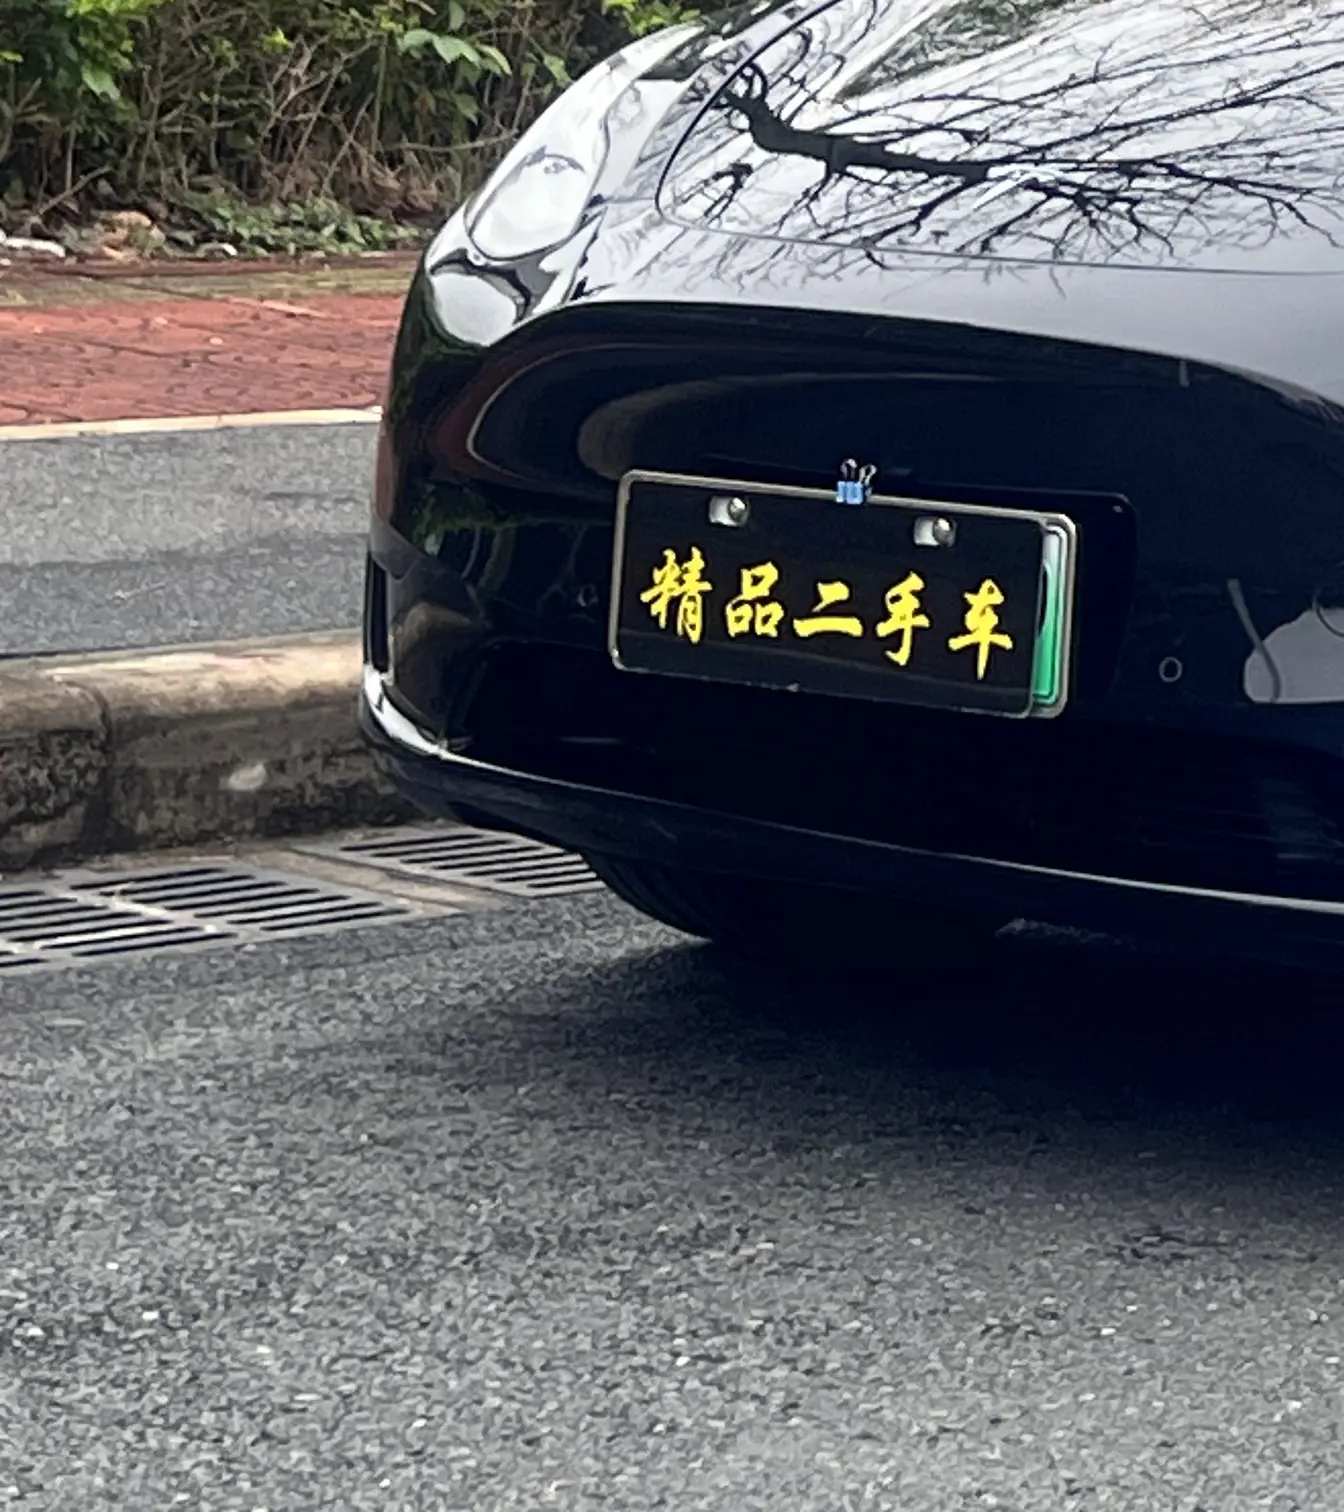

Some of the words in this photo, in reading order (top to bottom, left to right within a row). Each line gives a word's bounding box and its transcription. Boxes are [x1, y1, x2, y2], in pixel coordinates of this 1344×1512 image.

[639, 546, 1014, 681] 精品二手车
